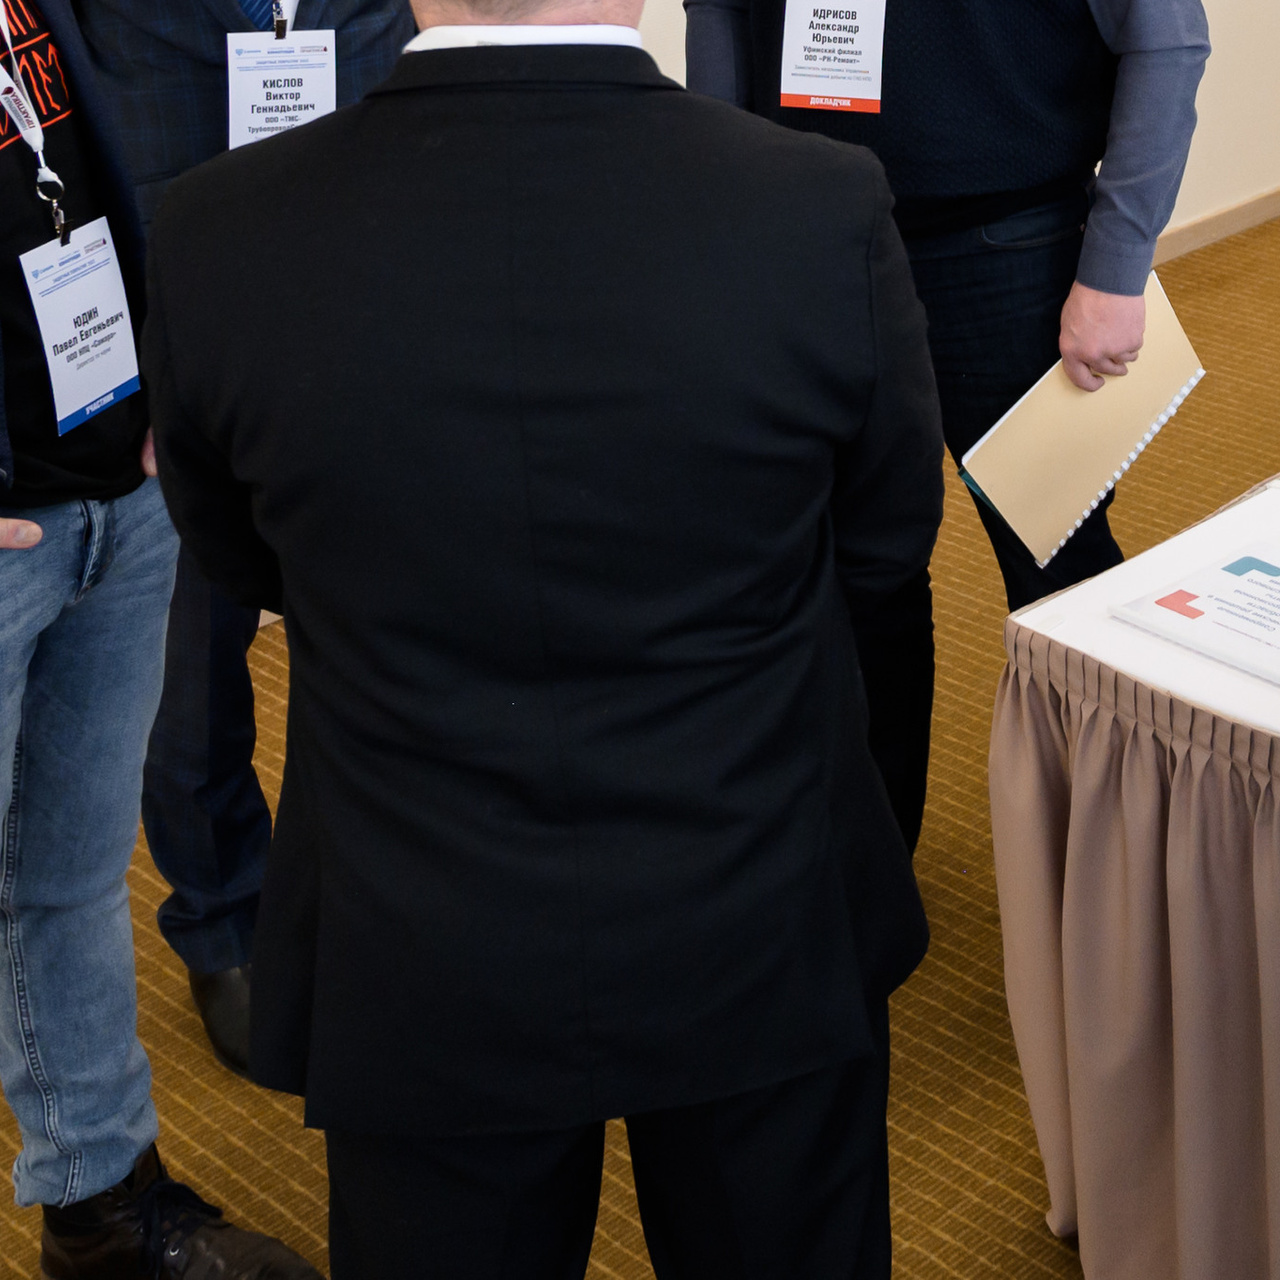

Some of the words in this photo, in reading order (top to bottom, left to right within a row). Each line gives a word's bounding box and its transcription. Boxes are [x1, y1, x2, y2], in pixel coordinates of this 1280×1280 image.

[812, 8, 858, 20] ИДРИСОВ
[808, 20, 860, 34] Александр
[812, 33, 855, 45] Юрьевич
[837, 47, 862, 56] филиал
[804, 54, 817, 62] ООО
[262, 78, 303, 89] КИСЛОВ
[265, 91, 301, 102] Виктор
[809, 96, 852, 107] ДОКЛАДЧИК
[9, 91, 36, 129] ПРАКТИКА
[251, 104, 315, 115] Геннадьевич
[72, 306, 99, 330] ЮДИН
[52, 334, 79, 357] Павел
[79, 311, 125, 343] Евгеньевич
[1216, 606, 1276, 632] Современные
